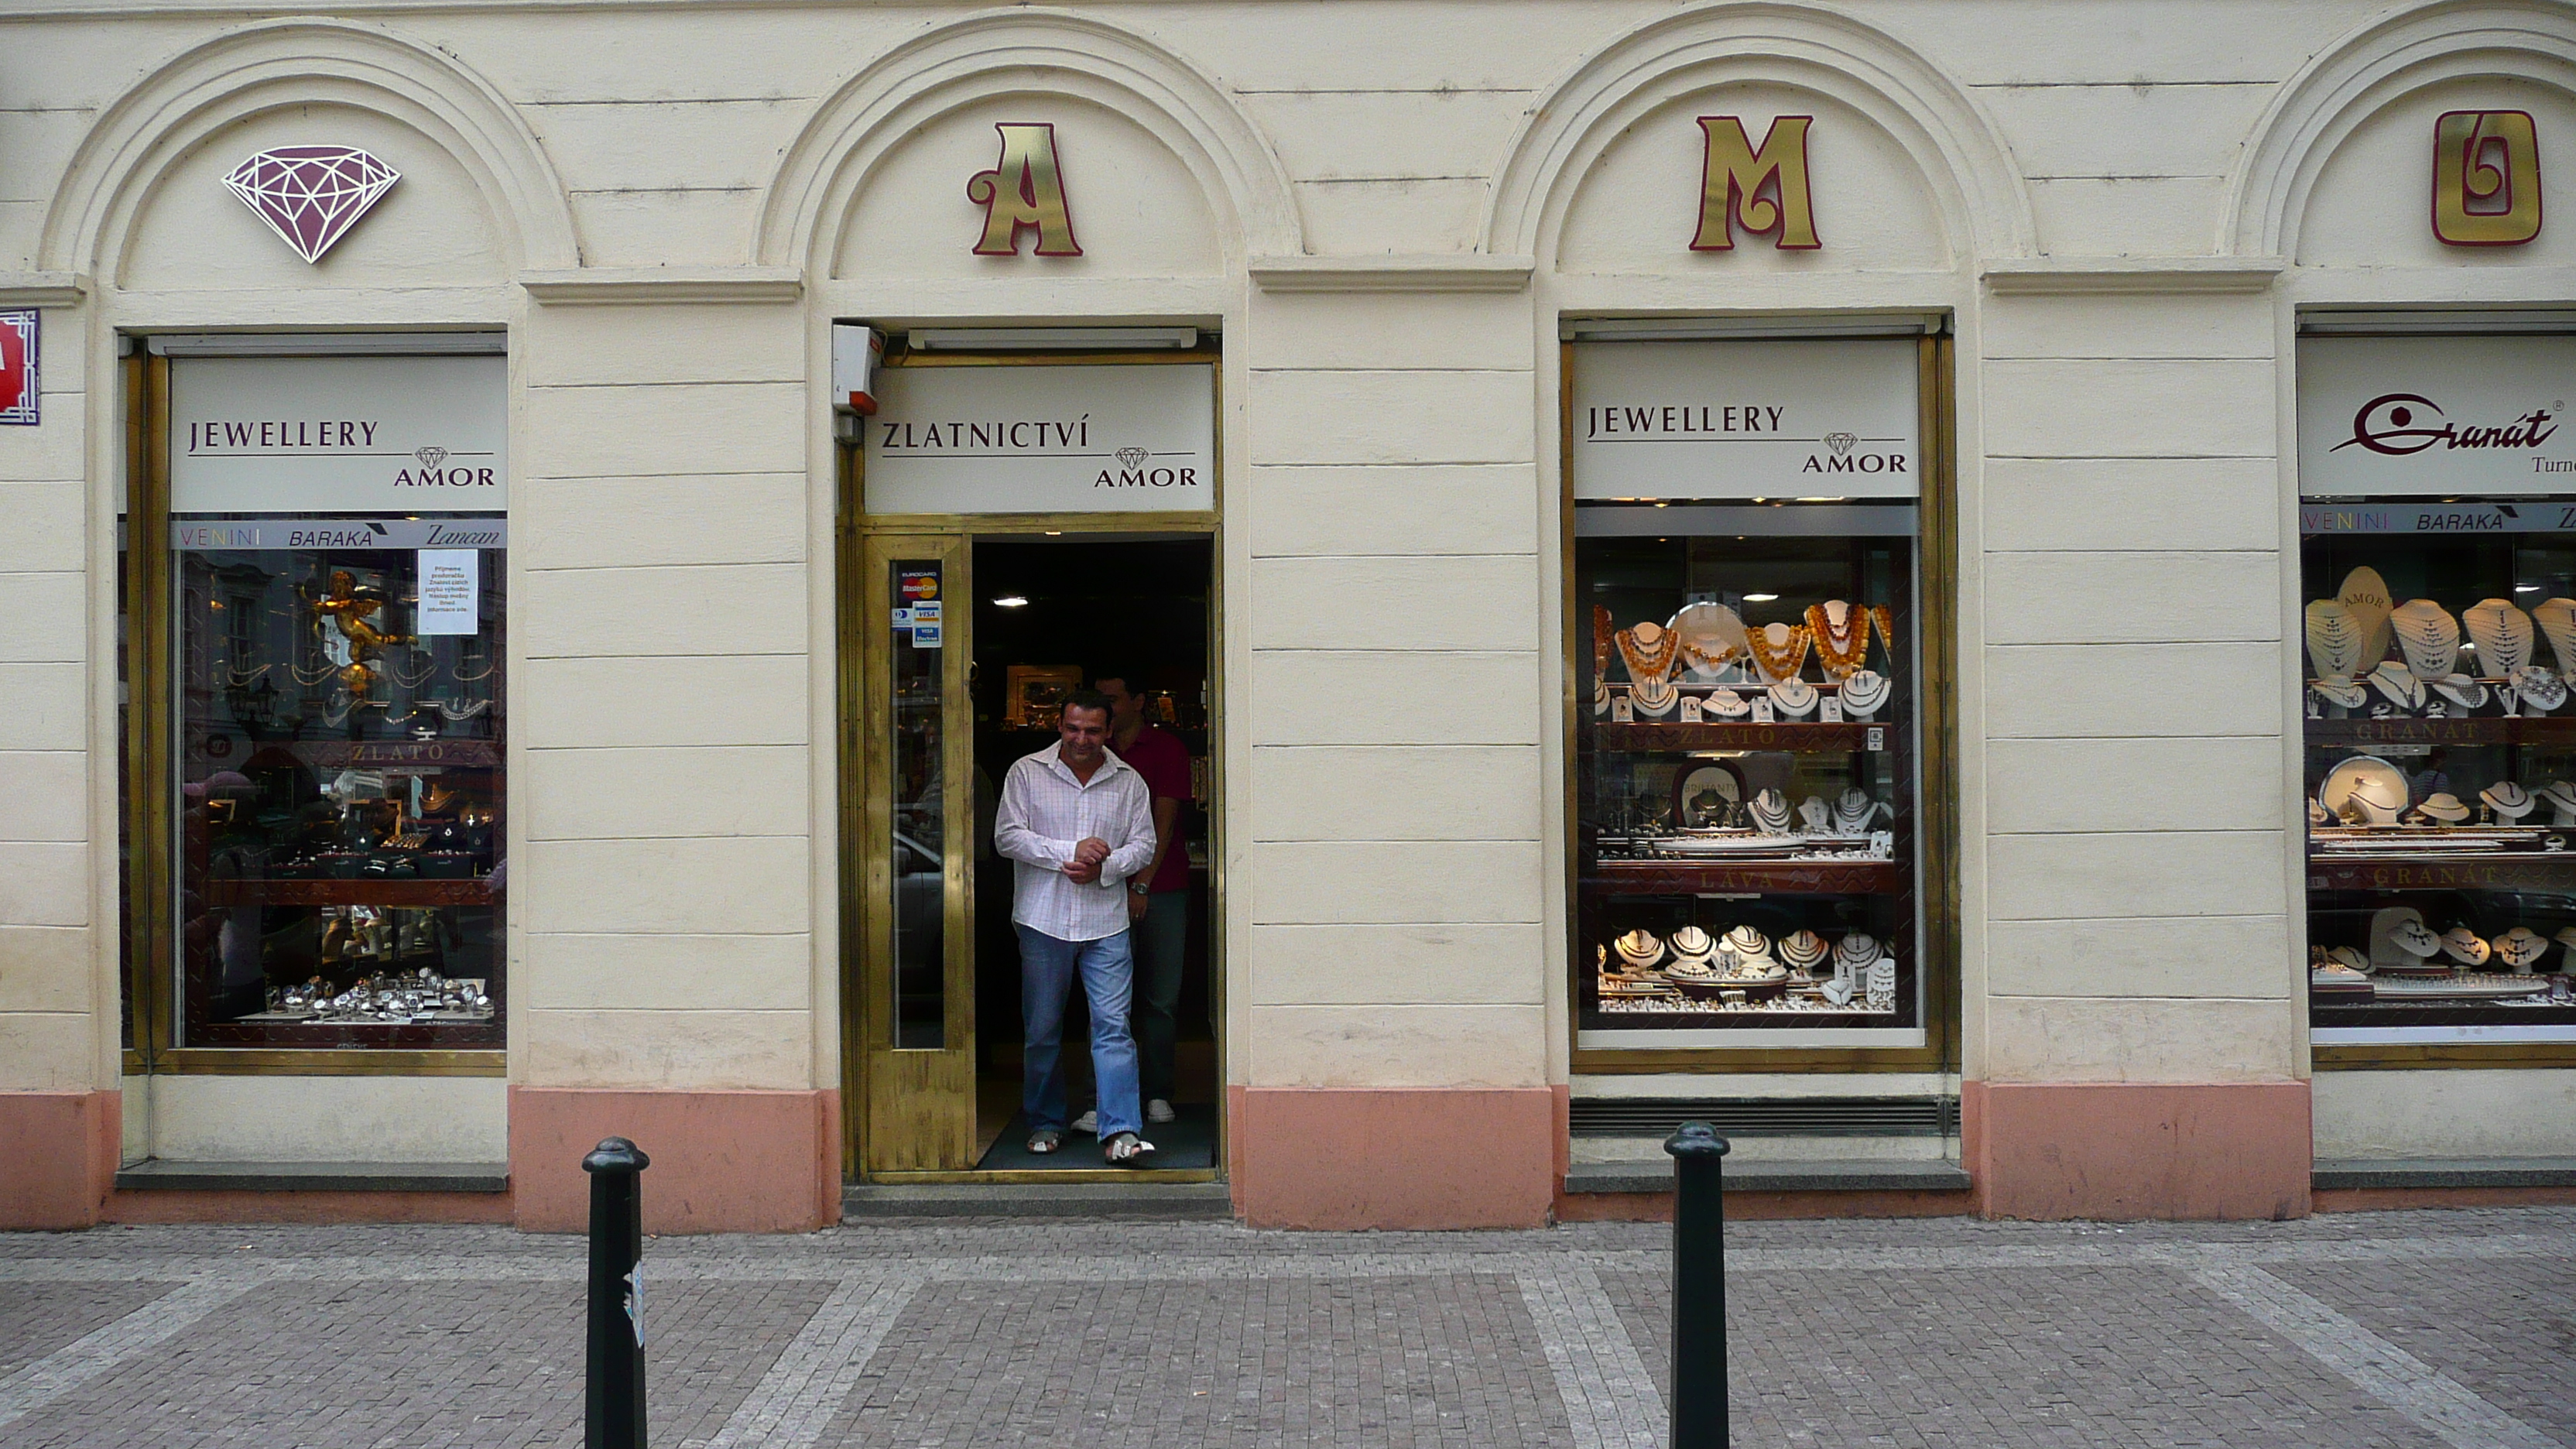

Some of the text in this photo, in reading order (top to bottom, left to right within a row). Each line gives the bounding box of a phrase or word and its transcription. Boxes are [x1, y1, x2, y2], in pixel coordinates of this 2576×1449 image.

[967, 110, 2543, 256] A M O
[882, 413, 1090, 448] ZLATNICTVÍ
[1588, 406, 1784, 438] JEWELLERY
[189, 421, 379, 453] JEWELLERY
[1802, 454, 1907, 474] AMOR
[393, 468, 495, 487] AMOR
[1094, 468, 1198, 488] AMOR
[2304, 512, 2388, 530] VENINI
[180, 528, 261, 546] VENINI
[426, 524, 500, 546] Zancan
[2345, 593, 2385, 609] AMOR
[1678, 727, 1776, 745] ZLATO
[352, 744, 444, 761] ZLATO
